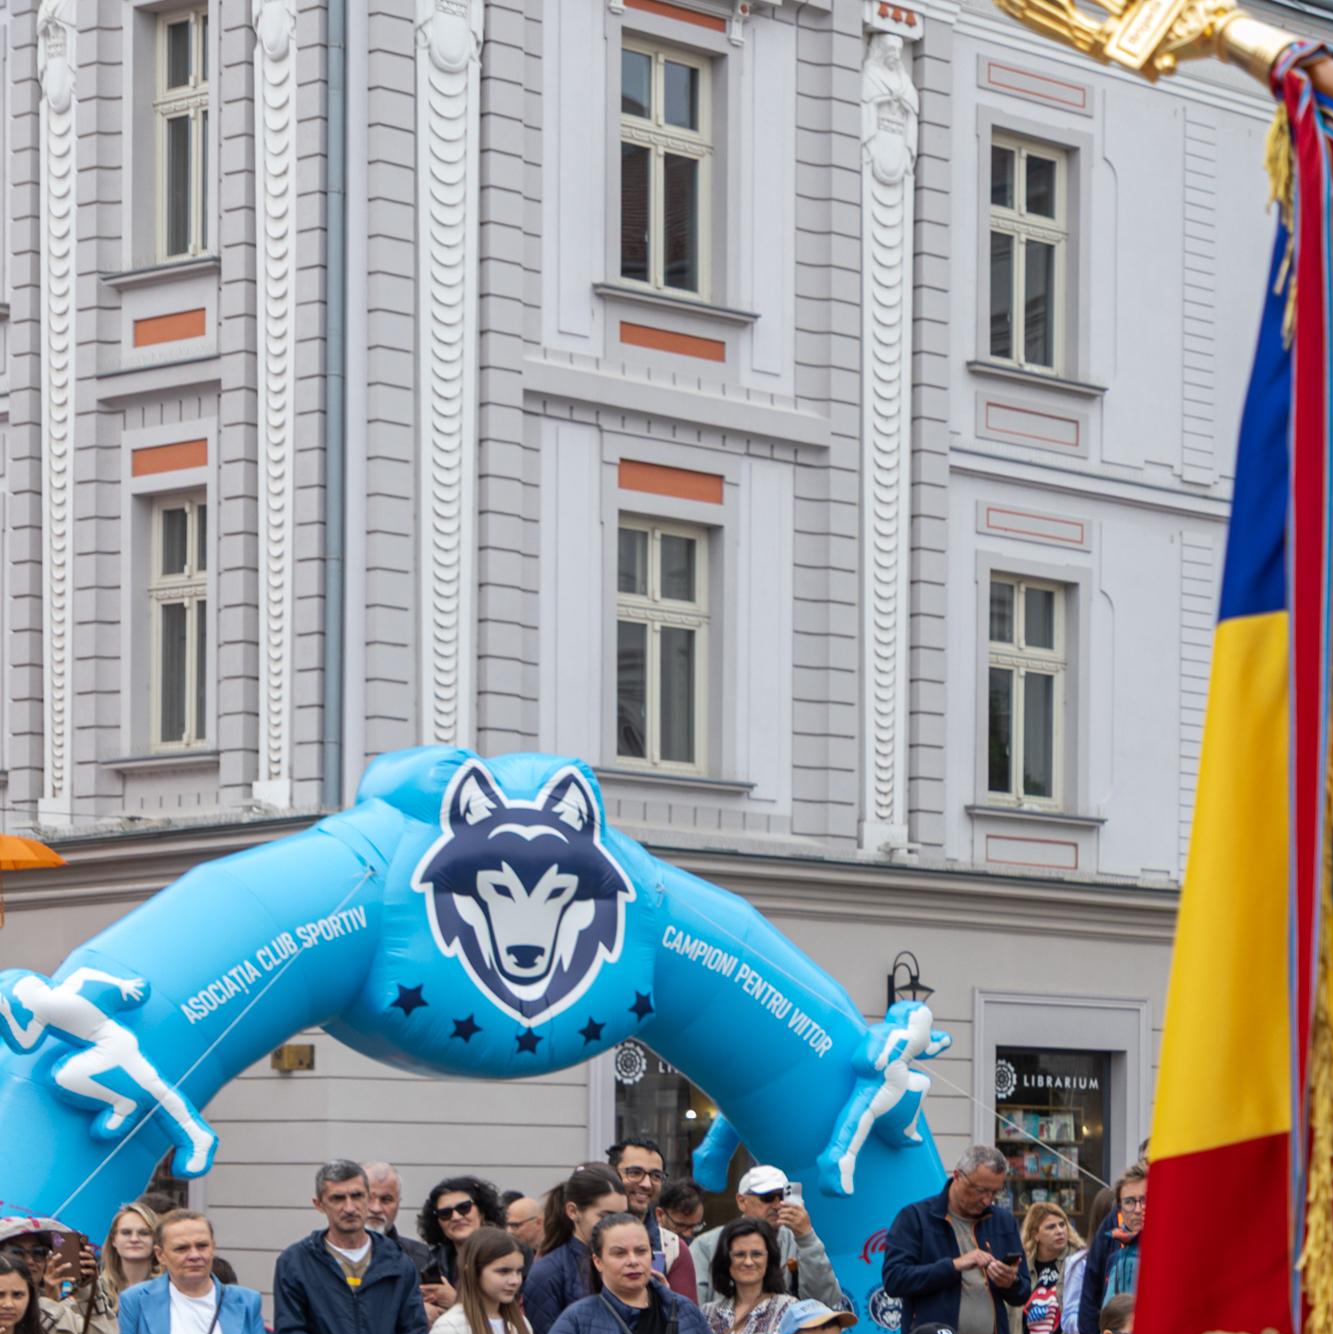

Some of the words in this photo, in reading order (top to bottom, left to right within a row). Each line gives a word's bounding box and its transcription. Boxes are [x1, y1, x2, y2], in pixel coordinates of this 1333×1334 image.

[256, 931, 298, 972] CLUB
[296, 905, 367, 949] SPORTIV
[662, 925, 739, 978] CAMPIONI
[734, 963, 794, 1020] PENTRU
[788, 1008, 833, 1058] VIITOR
[1023, 1074, 1099, 1090] LIBRARIUM
